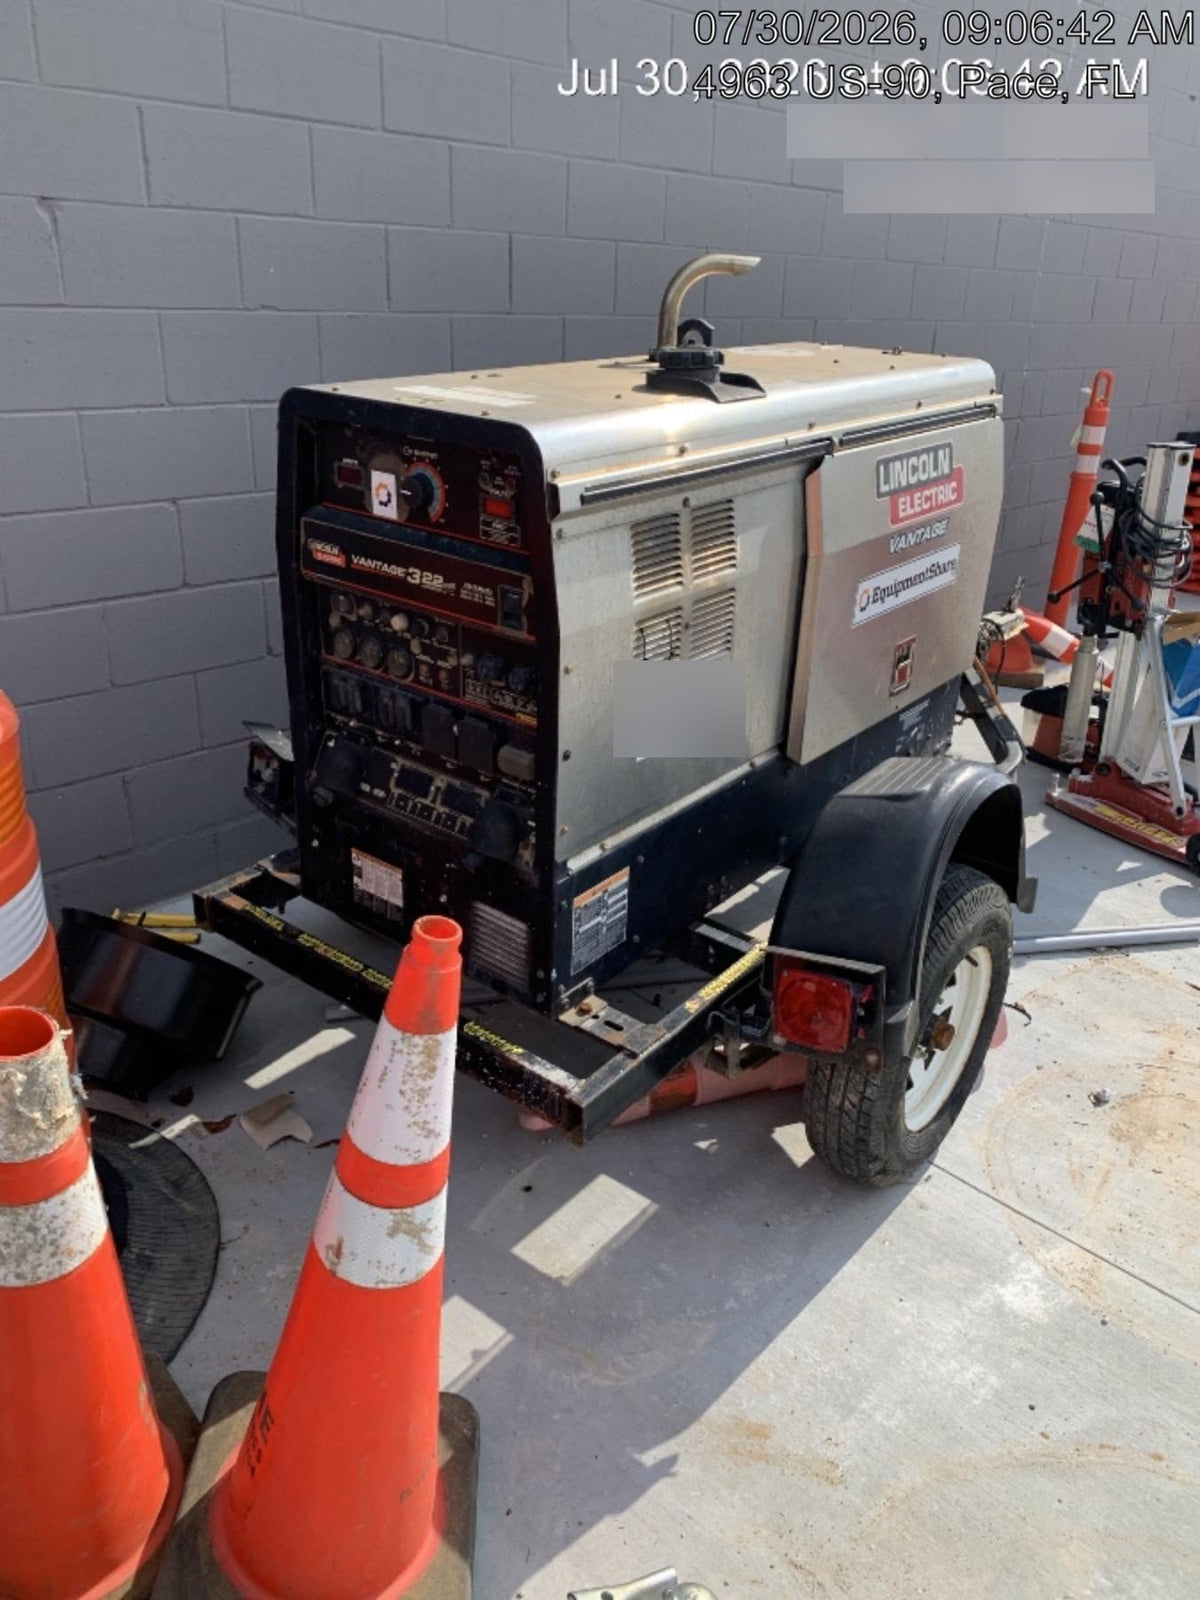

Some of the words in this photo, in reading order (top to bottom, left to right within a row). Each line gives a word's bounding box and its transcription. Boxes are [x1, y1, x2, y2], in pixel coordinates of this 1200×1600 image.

[879, 447, 950, 493] LINCOLN
[898, 481, 958, 518] ELECTRIC
[889, 519, 950, 554] VANTAGE
[351, 554, 407, 578] VANTAGE
[407, 566, 444, 588] 322
[872, 559, 957, 605] EquipmentShare
